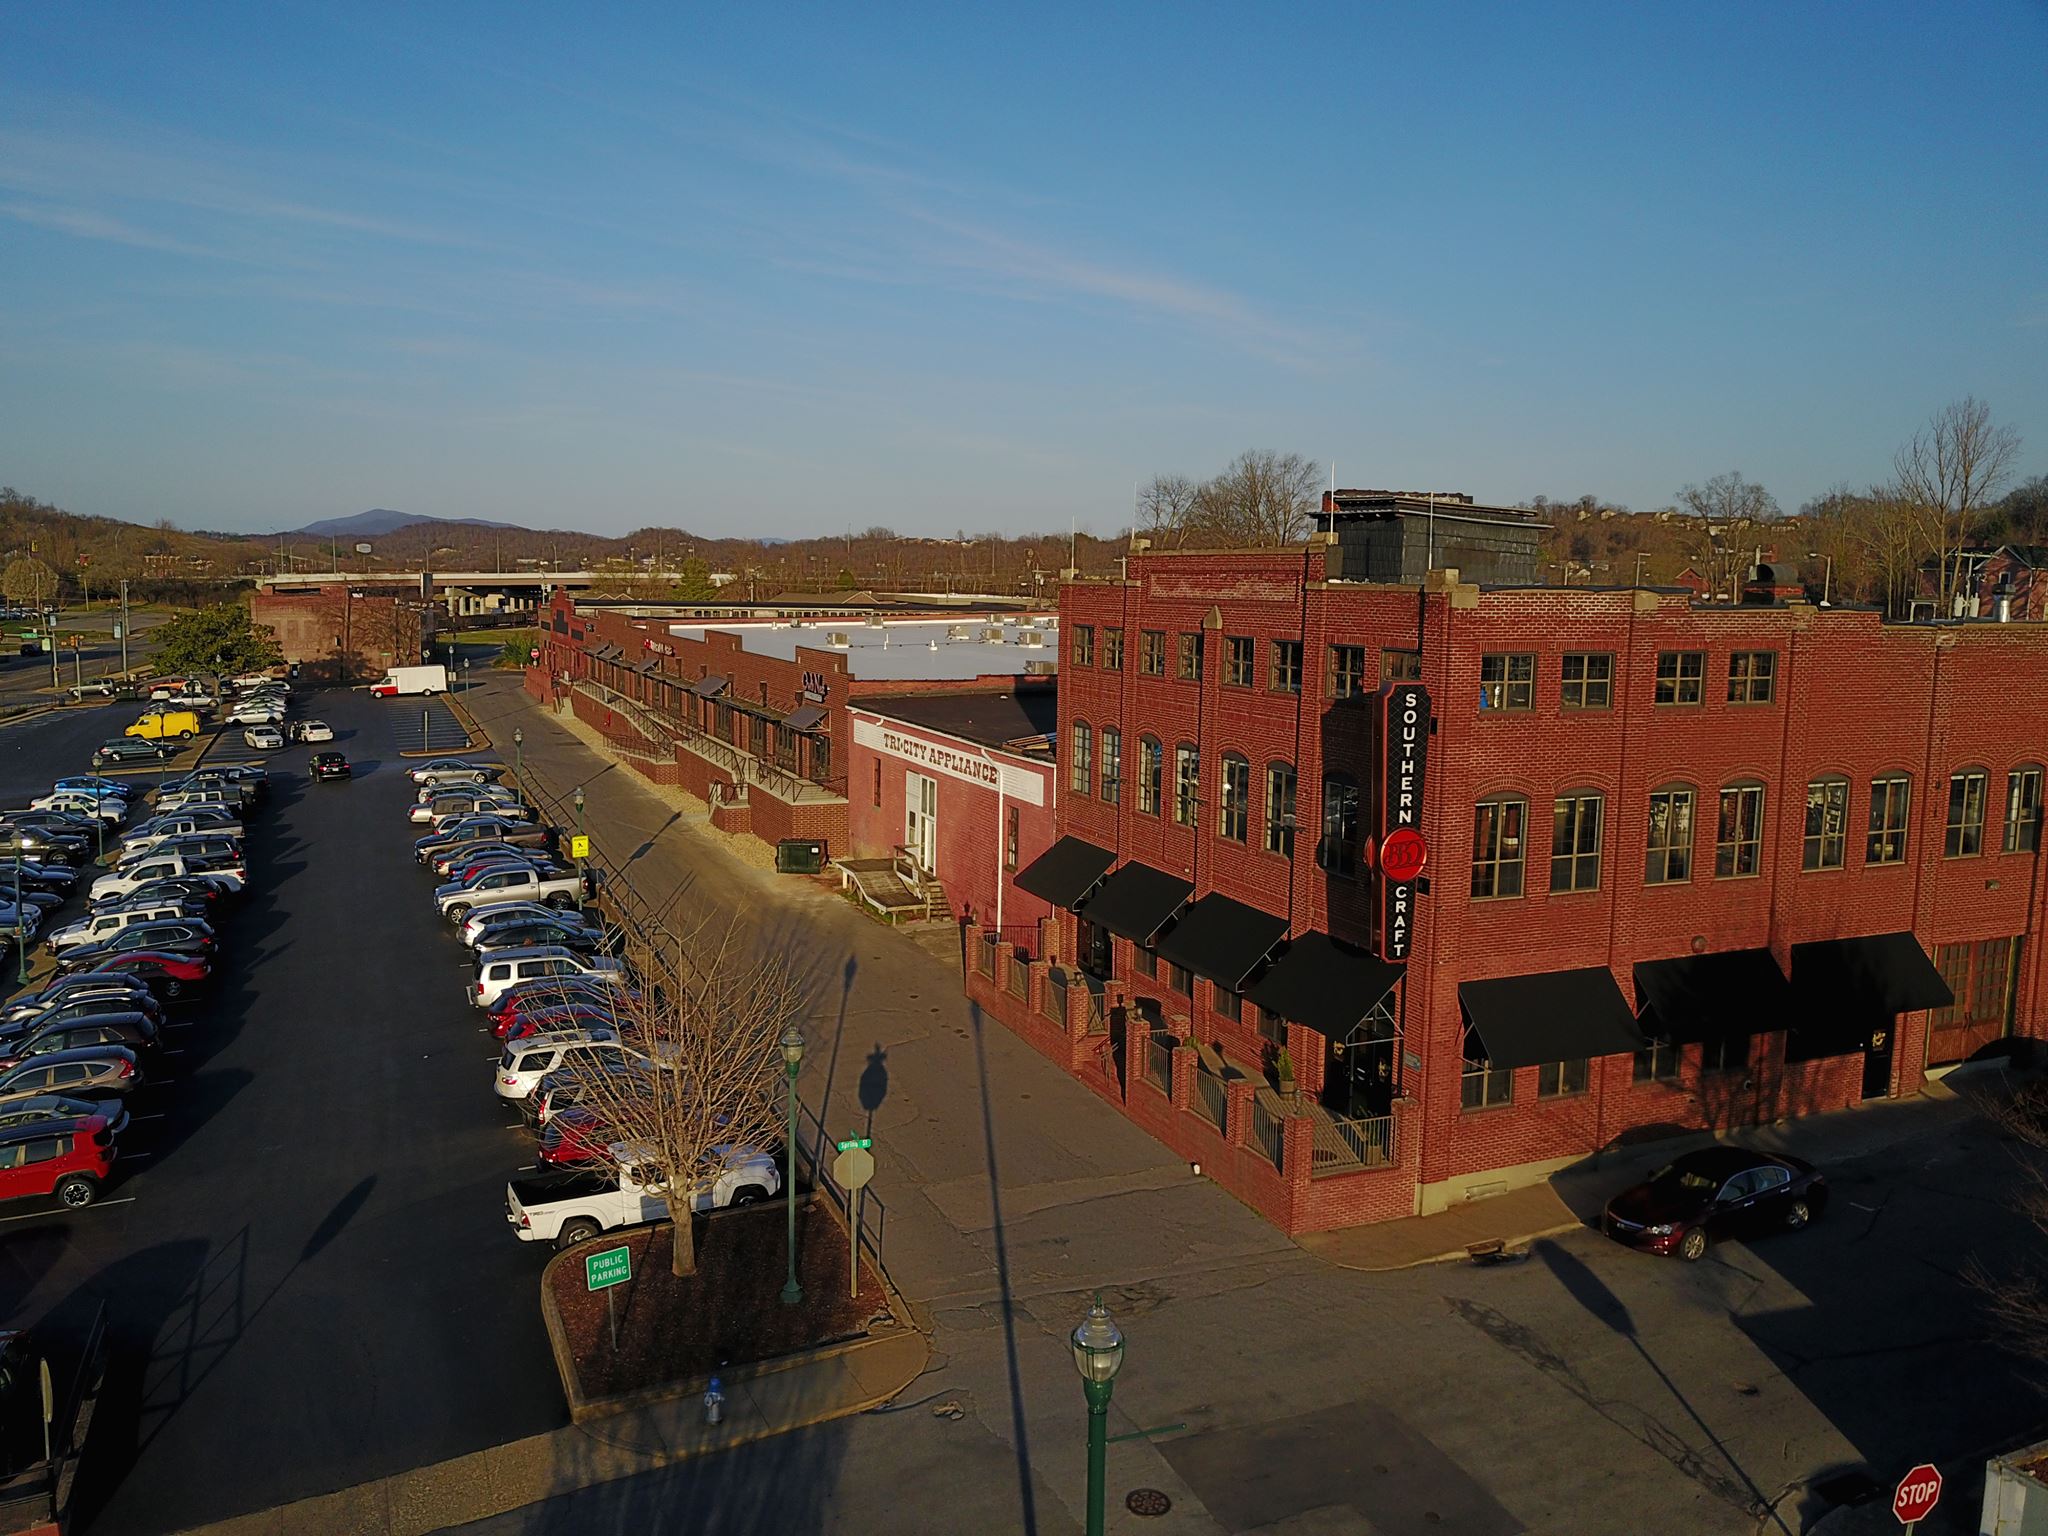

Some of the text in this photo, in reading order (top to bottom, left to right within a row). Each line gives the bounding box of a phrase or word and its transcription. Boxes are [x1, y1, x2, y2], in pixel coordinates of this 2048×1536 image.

[928, 747, 998, 785] APPLIANCE
[1398, 693, 1417, 824] SOUTHERN
[1393, 886, 1408, 957] CRAFT
[591, 1265, 628, 1284] PARKING
[593, 1254, 623, 1271] PUBLIC
[1897, 1480, 1938, 1507] STOP
